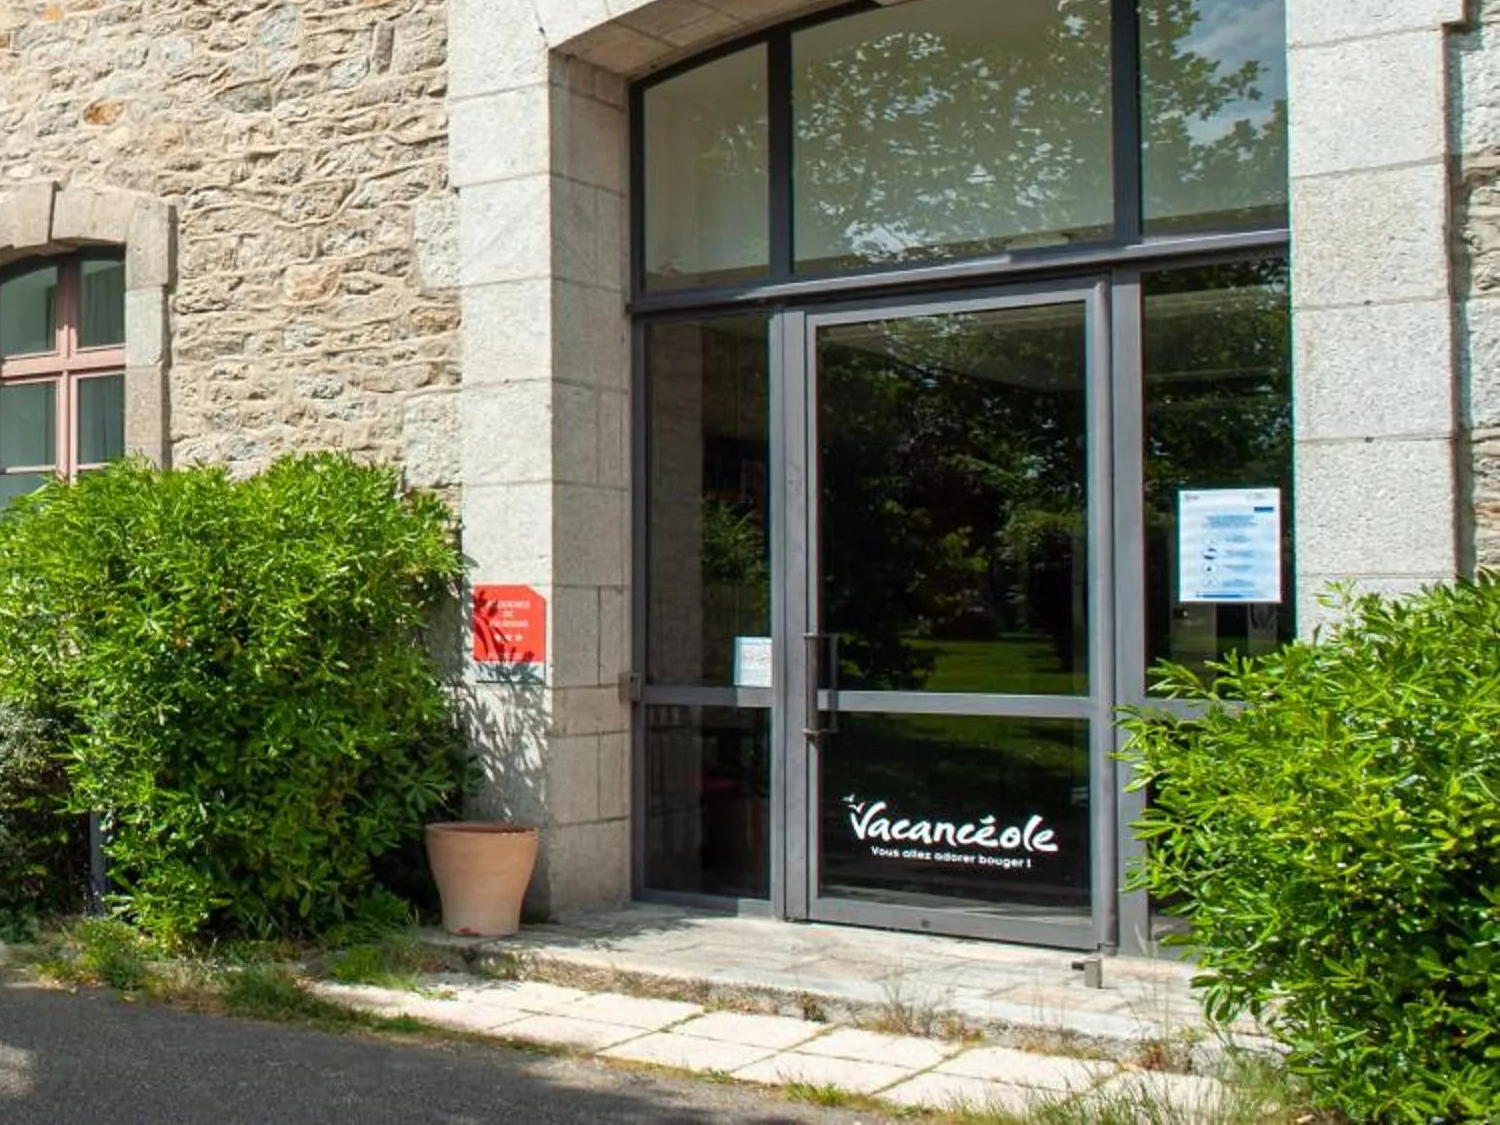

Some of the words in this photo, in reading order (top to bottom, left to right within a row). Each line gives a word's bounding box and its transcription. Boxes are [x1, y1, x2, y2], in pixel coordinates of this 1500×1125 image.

[850, 801, 1059, 852] Vacancéole
[871, 846, 899, 858] Vous
[902, 849, 931, 860] allez
[934, 851, 975, 863] adorer
